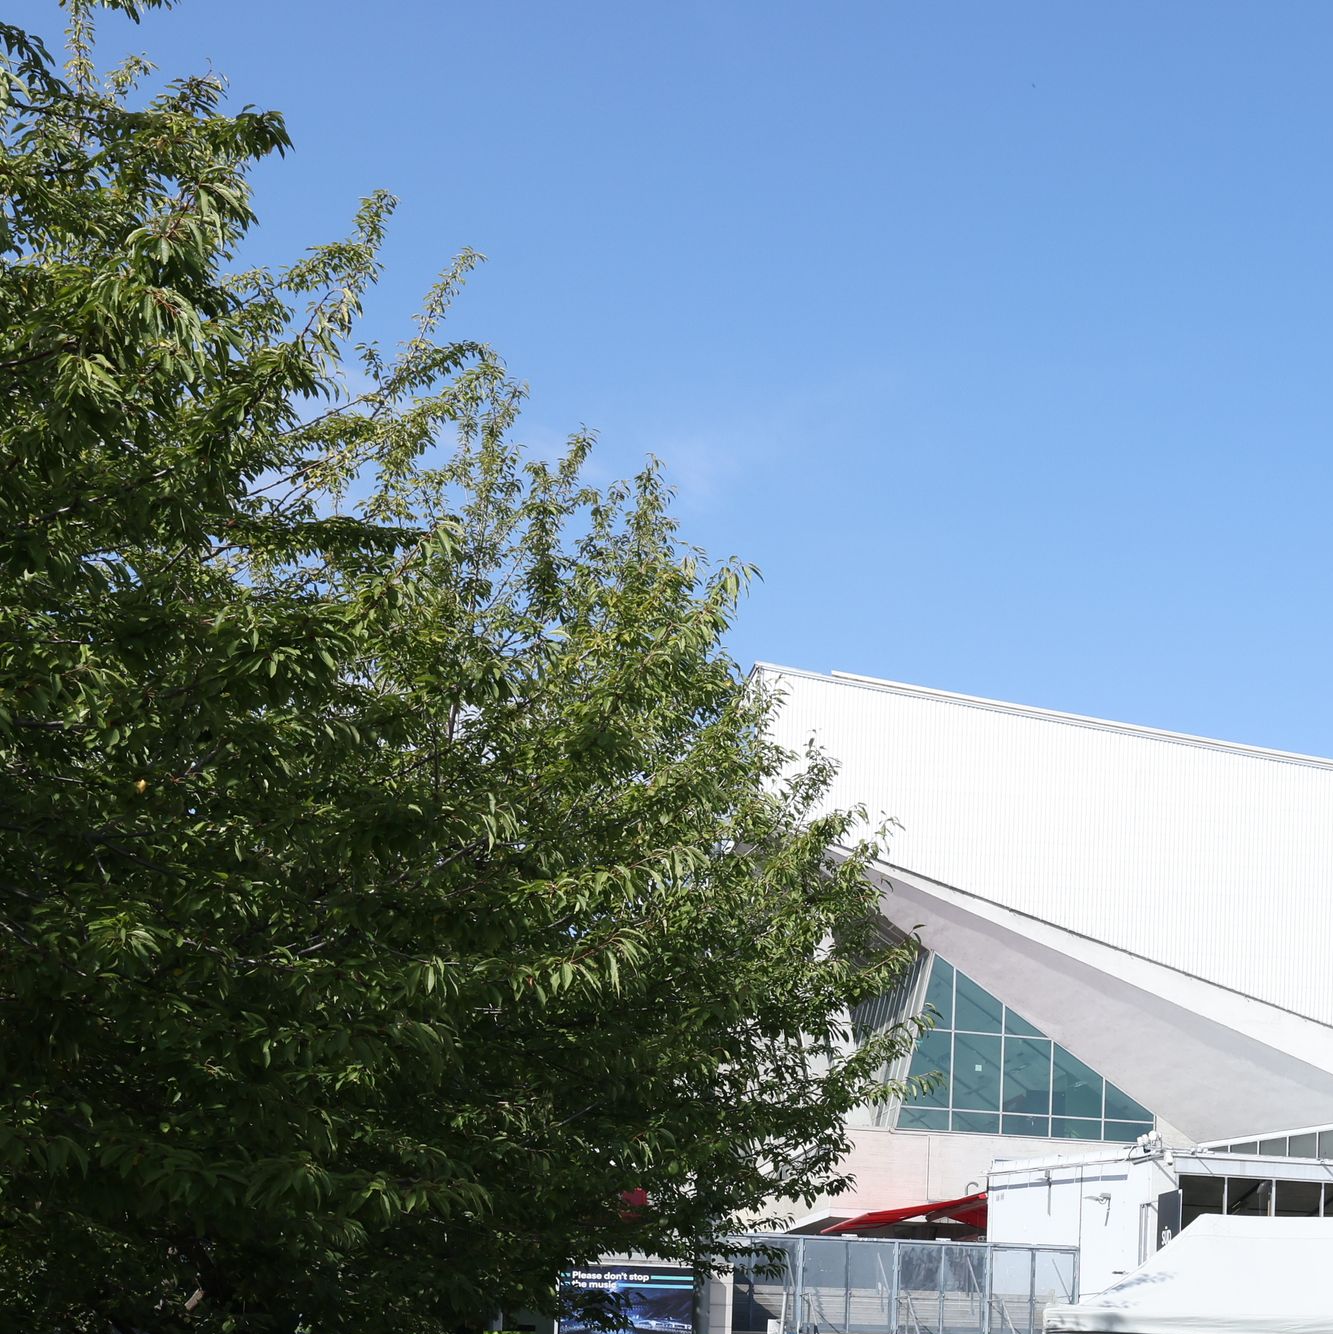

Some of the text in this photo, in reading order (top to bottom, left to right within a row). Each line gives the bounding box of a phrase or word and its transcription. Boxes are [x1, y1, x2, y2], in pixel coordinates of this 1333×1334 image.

[571, 1271, 650, 1283] Please don't stop
[588, 1280, 618, 1289] music
